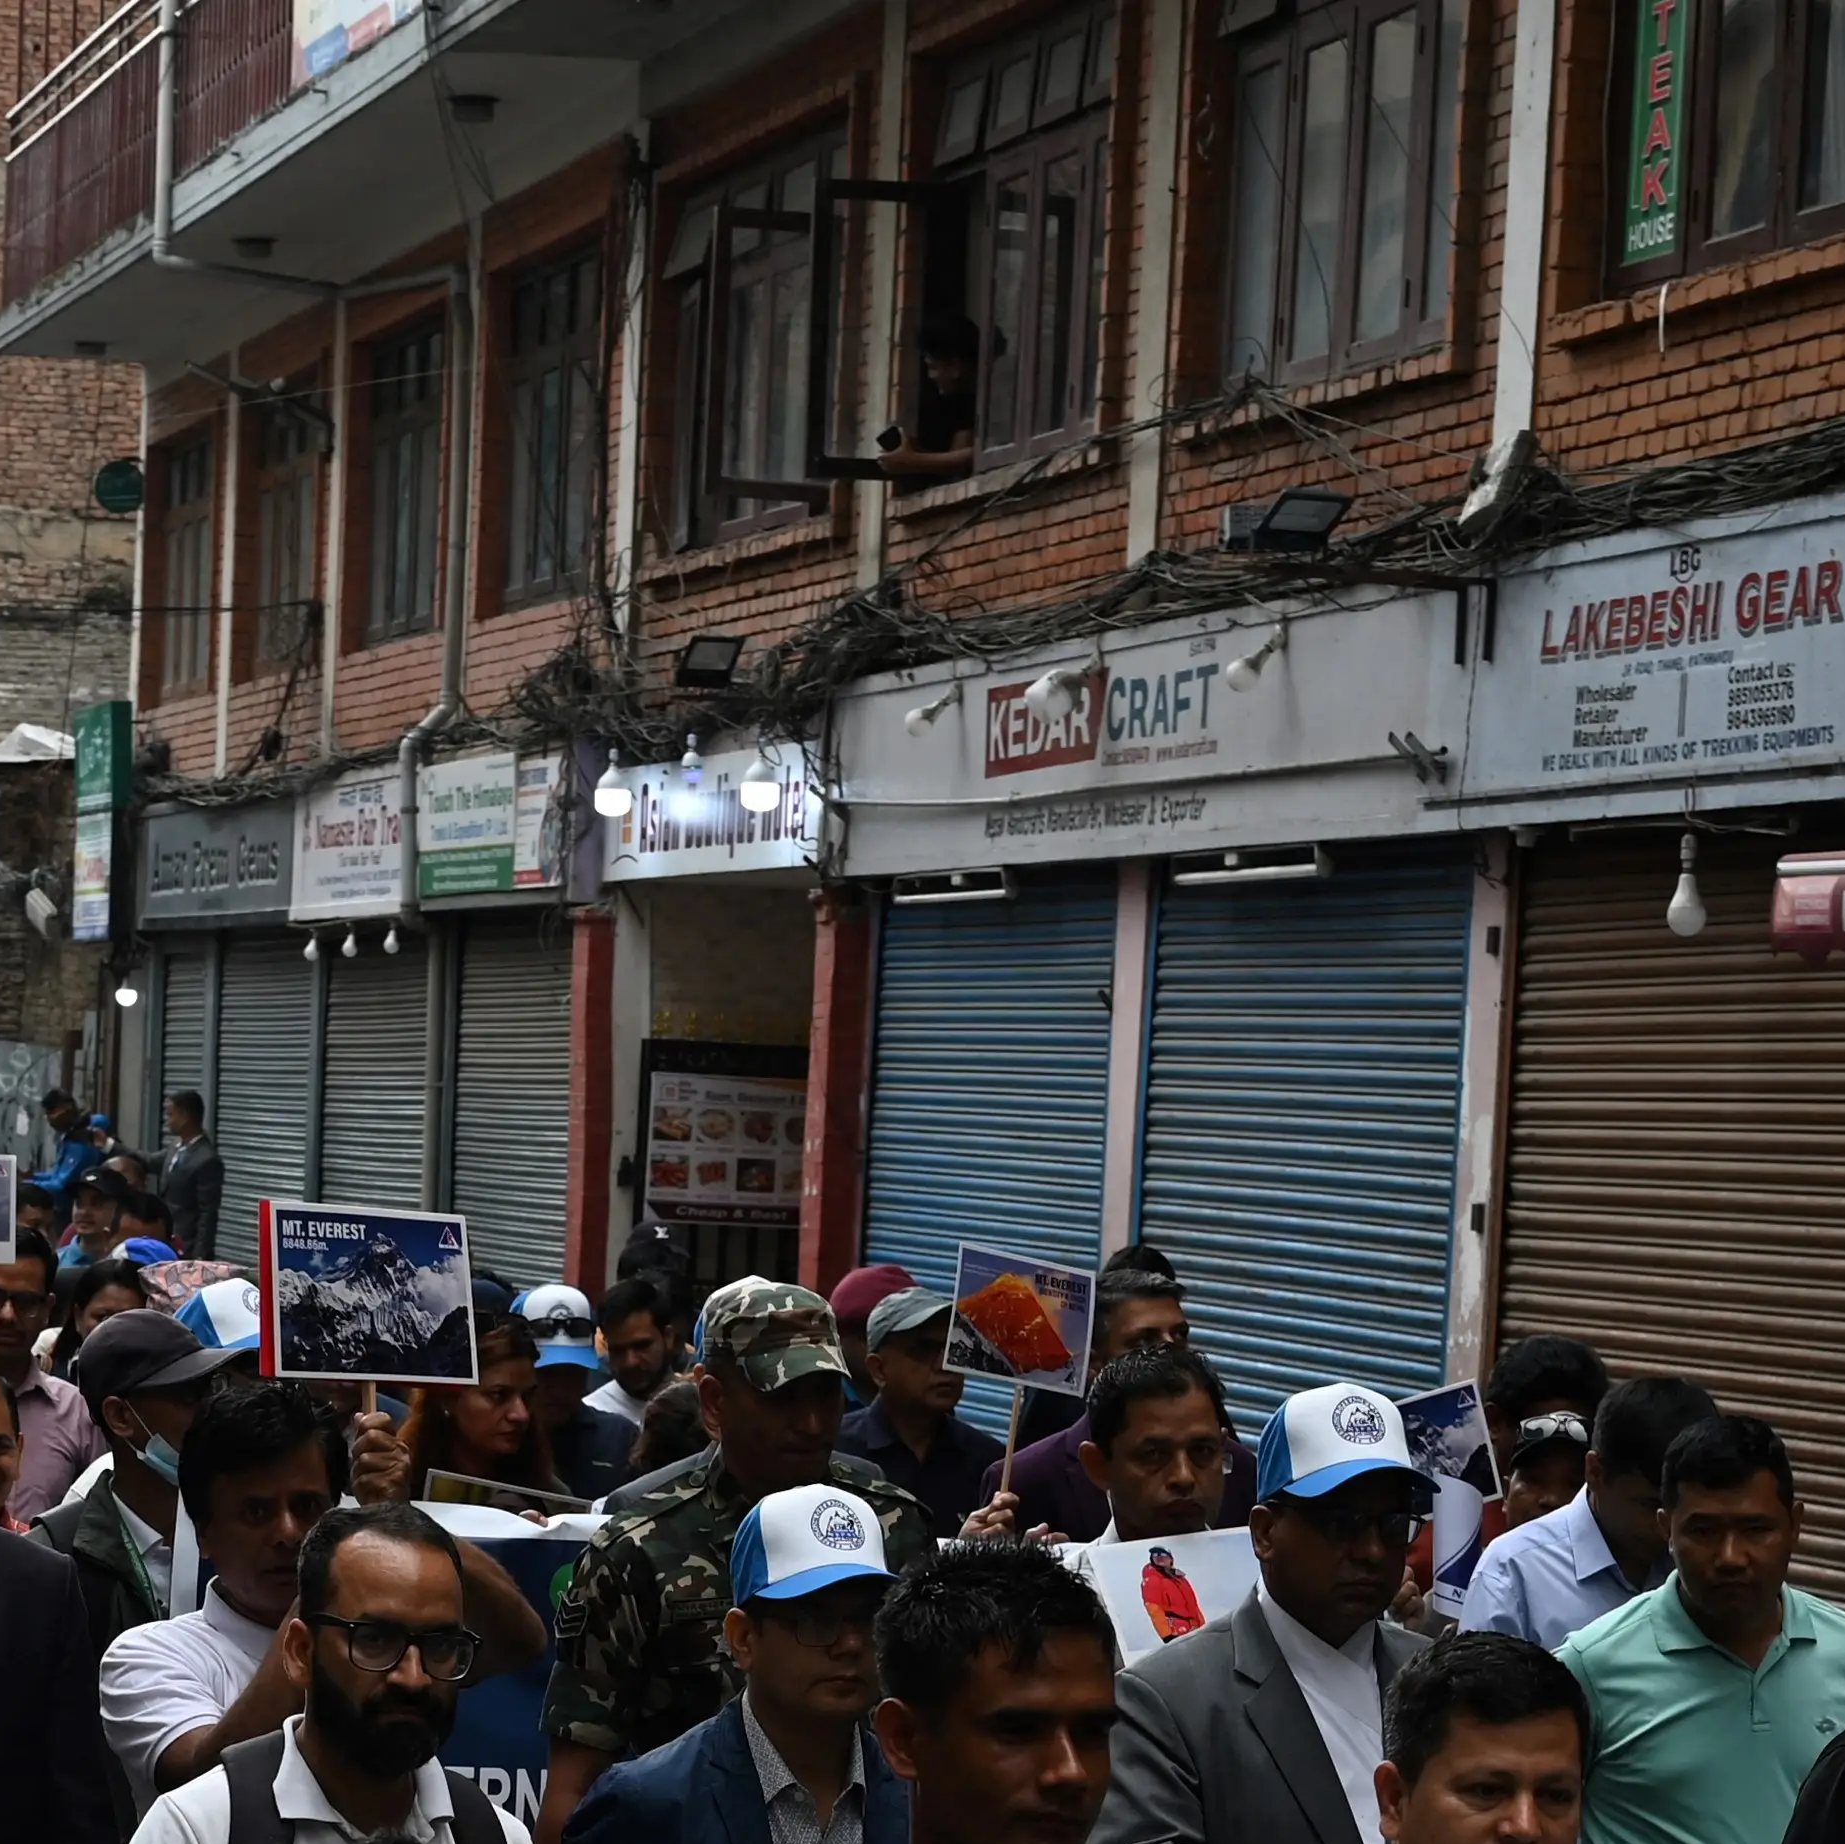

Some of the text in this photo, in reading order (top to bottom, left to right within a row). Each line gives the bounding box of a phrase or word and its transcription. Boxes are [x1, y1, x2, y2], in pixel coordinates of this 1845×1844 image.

[1628, 212, 1675, 252] HOUSE
[1540, 560, 1844, 664] LAKEBESHI GEAR
[1728, 661, 1775, 684] Contact
[1576, 684, 1637, 705] Wholesaler
[988, 663, 1219, 762] KEDAR CRAFT
[1574, 706, 1619, 726] Retailer
[1542, 754, 1556, 771] WE
[1592, 748, 1616, 767] WITH
[1619, 745, 1639, 766] ALL
[1643, 743, 1678, 764] KINDS
[1682, 741, 1697, 760] OF
[1702, 734, 1758, 757] TREKKING
[1762, 725, 1835, 752] EQUIPMENTS
[1573, 726, 1648, 747] Manufacturer
[1160, 790, 1207, 829] Exporter
[236, 834, 279, 890] Gems
[675, 1205, 788, 1221] Cheap & Best
[282, 1219, 367, 1240] MT. EVEREST
[1051, 1276, 1087, 1295] EVEREST
